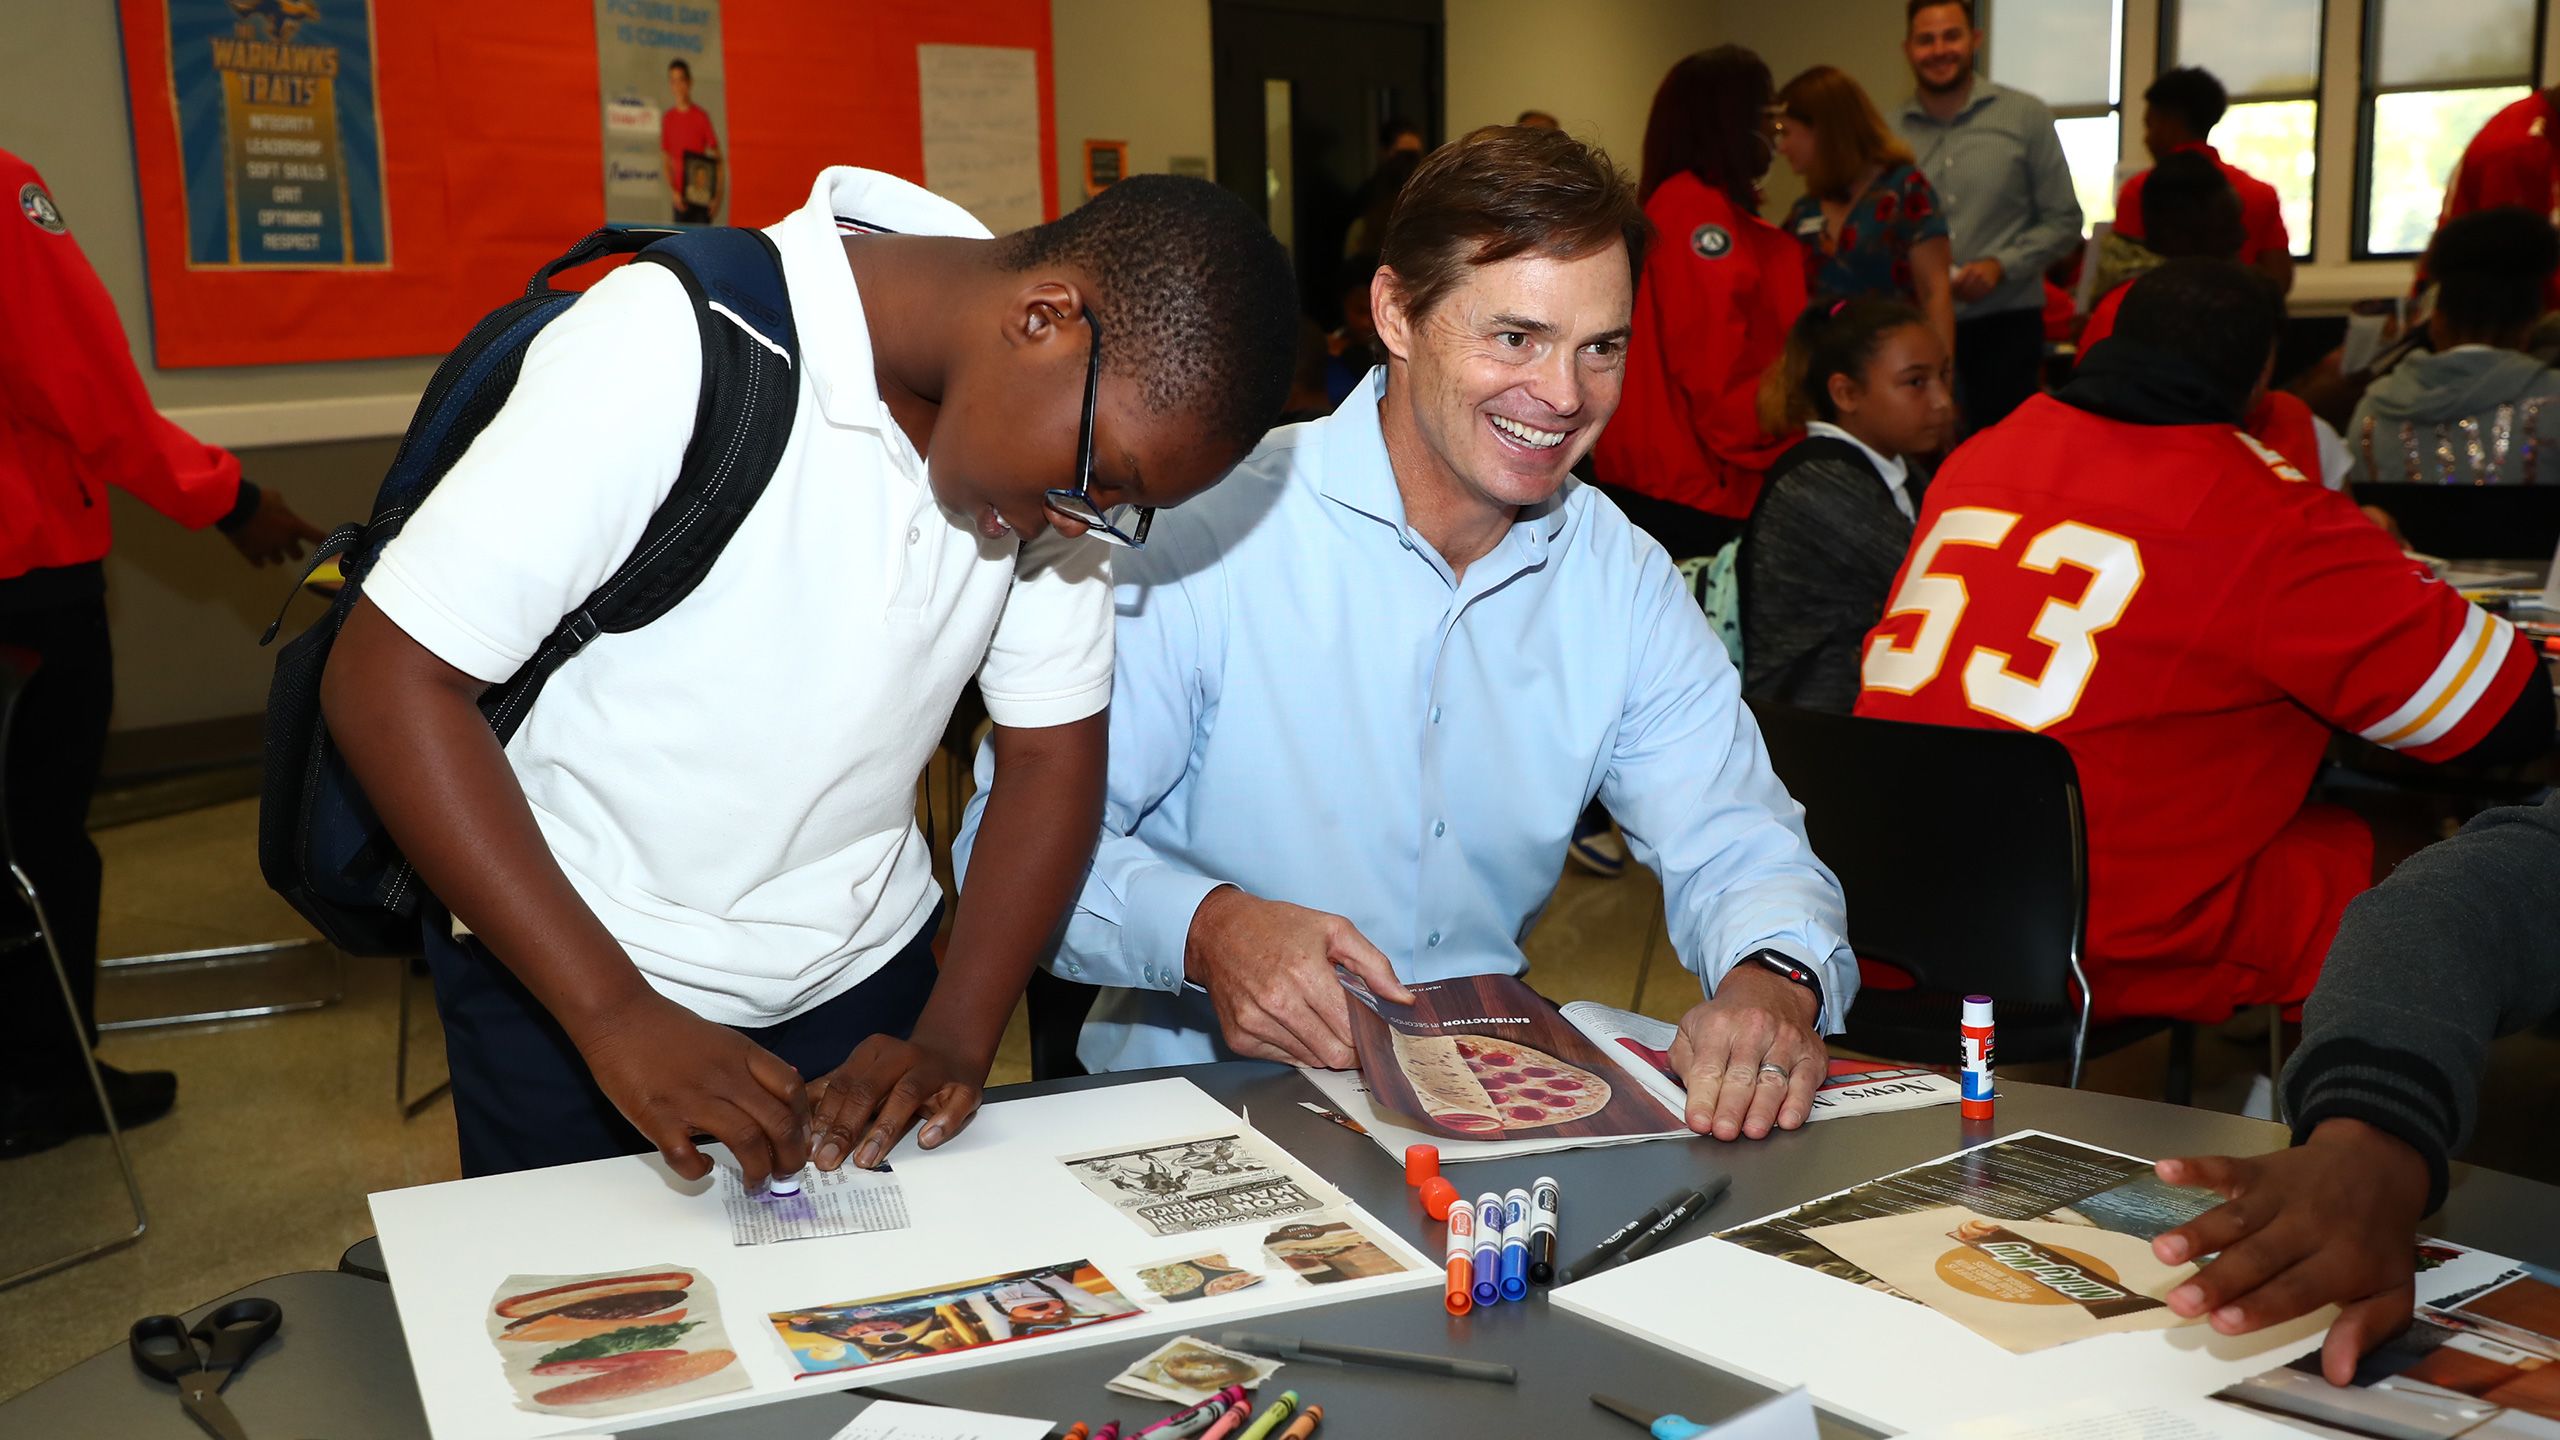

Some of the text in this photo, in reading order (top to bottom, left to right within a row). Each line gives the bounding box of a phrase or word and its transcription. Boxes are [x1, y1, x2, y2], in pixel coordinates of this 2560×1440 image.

[607, 0, 709, 25] PICTURE DAY
[617, 25, 704, 54] IS COMING
[210, 36, 339, 77] WARHAWKS
[240, 73, 318, 105] TRAITS
[249, 113, 314, 132] INTEGRITY
[246, 138, 323, 156] LEADERSHIP
[246, 161, 328, 181] SOFT SKILLS
[258, 209, 323, 227] OPTIMISM
[262, 233, 320, 250] RESPECT
[1861, 505, 2145, 733] 53
[1442, 1016, 1531, 1028] SATISFACTION
[1841, 1080, 1937, 1100] News
[1228, 1184, 1297, 1202] MAN
[1232, 1193, 1308, 1211] IRON
[1143, 1198, 1219, 1217] AMERICA
[1151, 1206, 1230, 1226] CAPTAIN
[1191, 1214, 1249, 1229] COMICS
[1978, 1242, 2053, 1270] Way
[2031, 1265, 2127, 1300] Milky
